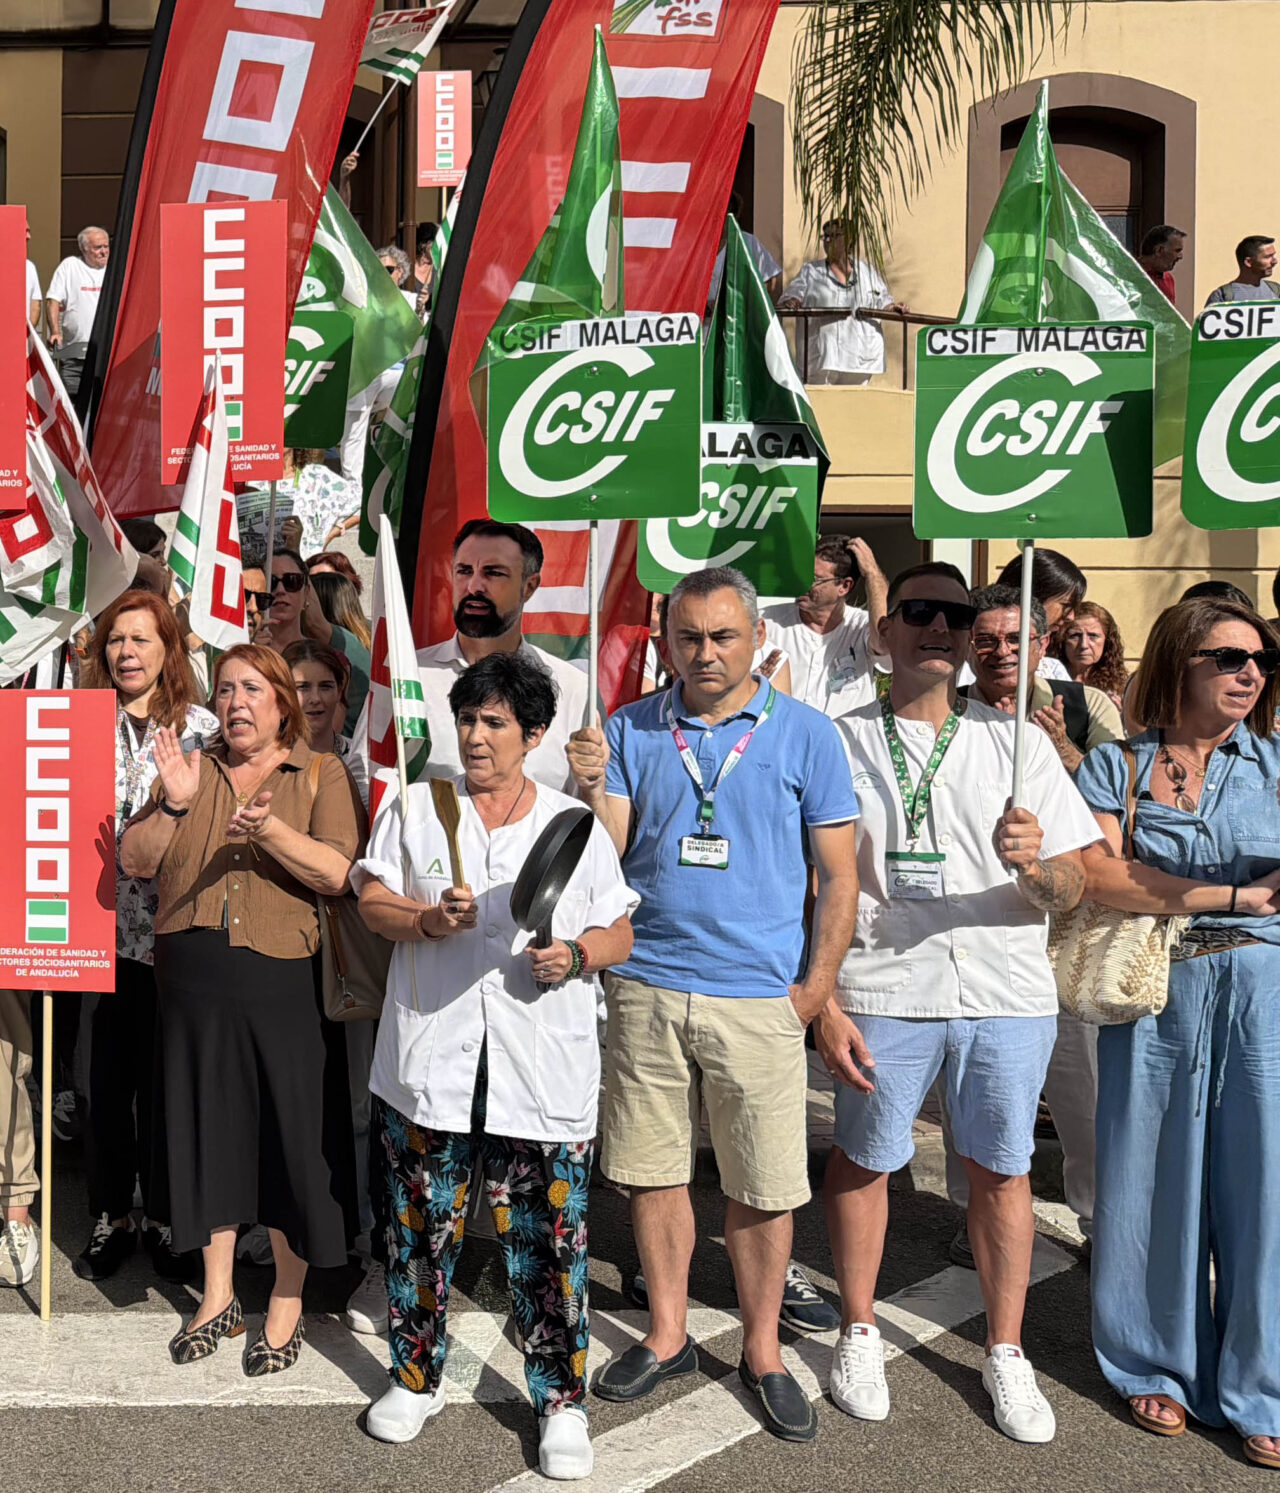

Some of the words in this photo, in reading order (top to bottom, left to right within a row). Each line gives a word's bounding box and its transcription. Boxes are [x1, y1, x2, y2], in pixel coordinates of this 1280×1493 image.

[435, 74, 454, 150] CCOO
[499, 324, 562, 352] CSIF
[579, 315, 696, 348] MALAGA
[1199, 307, 1275, 340] CSIF
[927, 327, 999, 354] CSIF
[1017, 325, 1146, 352] MALAGA
[533, 389, 676, 445] CSIF
[966, 399, 1124, 456] CSIF
[234, 444, 269, 453] SANIDAD
[270, 443, 276, 451] Y
[12, 469, 18, 477] Y
[26, 696, 70, 892] CCOO
[687, 845, 723, 854] SINDICAL
[32, 958, 111, 969] SOCIOSANITARIOS
[46, 948, 58, 956] DE
[60, 948, 98, 958] SANIDAD
[100, 950, 106, 958] Y
[16, 968, 27, 977] DE
[29, 968, 79, 978] ANDALUCÍA
